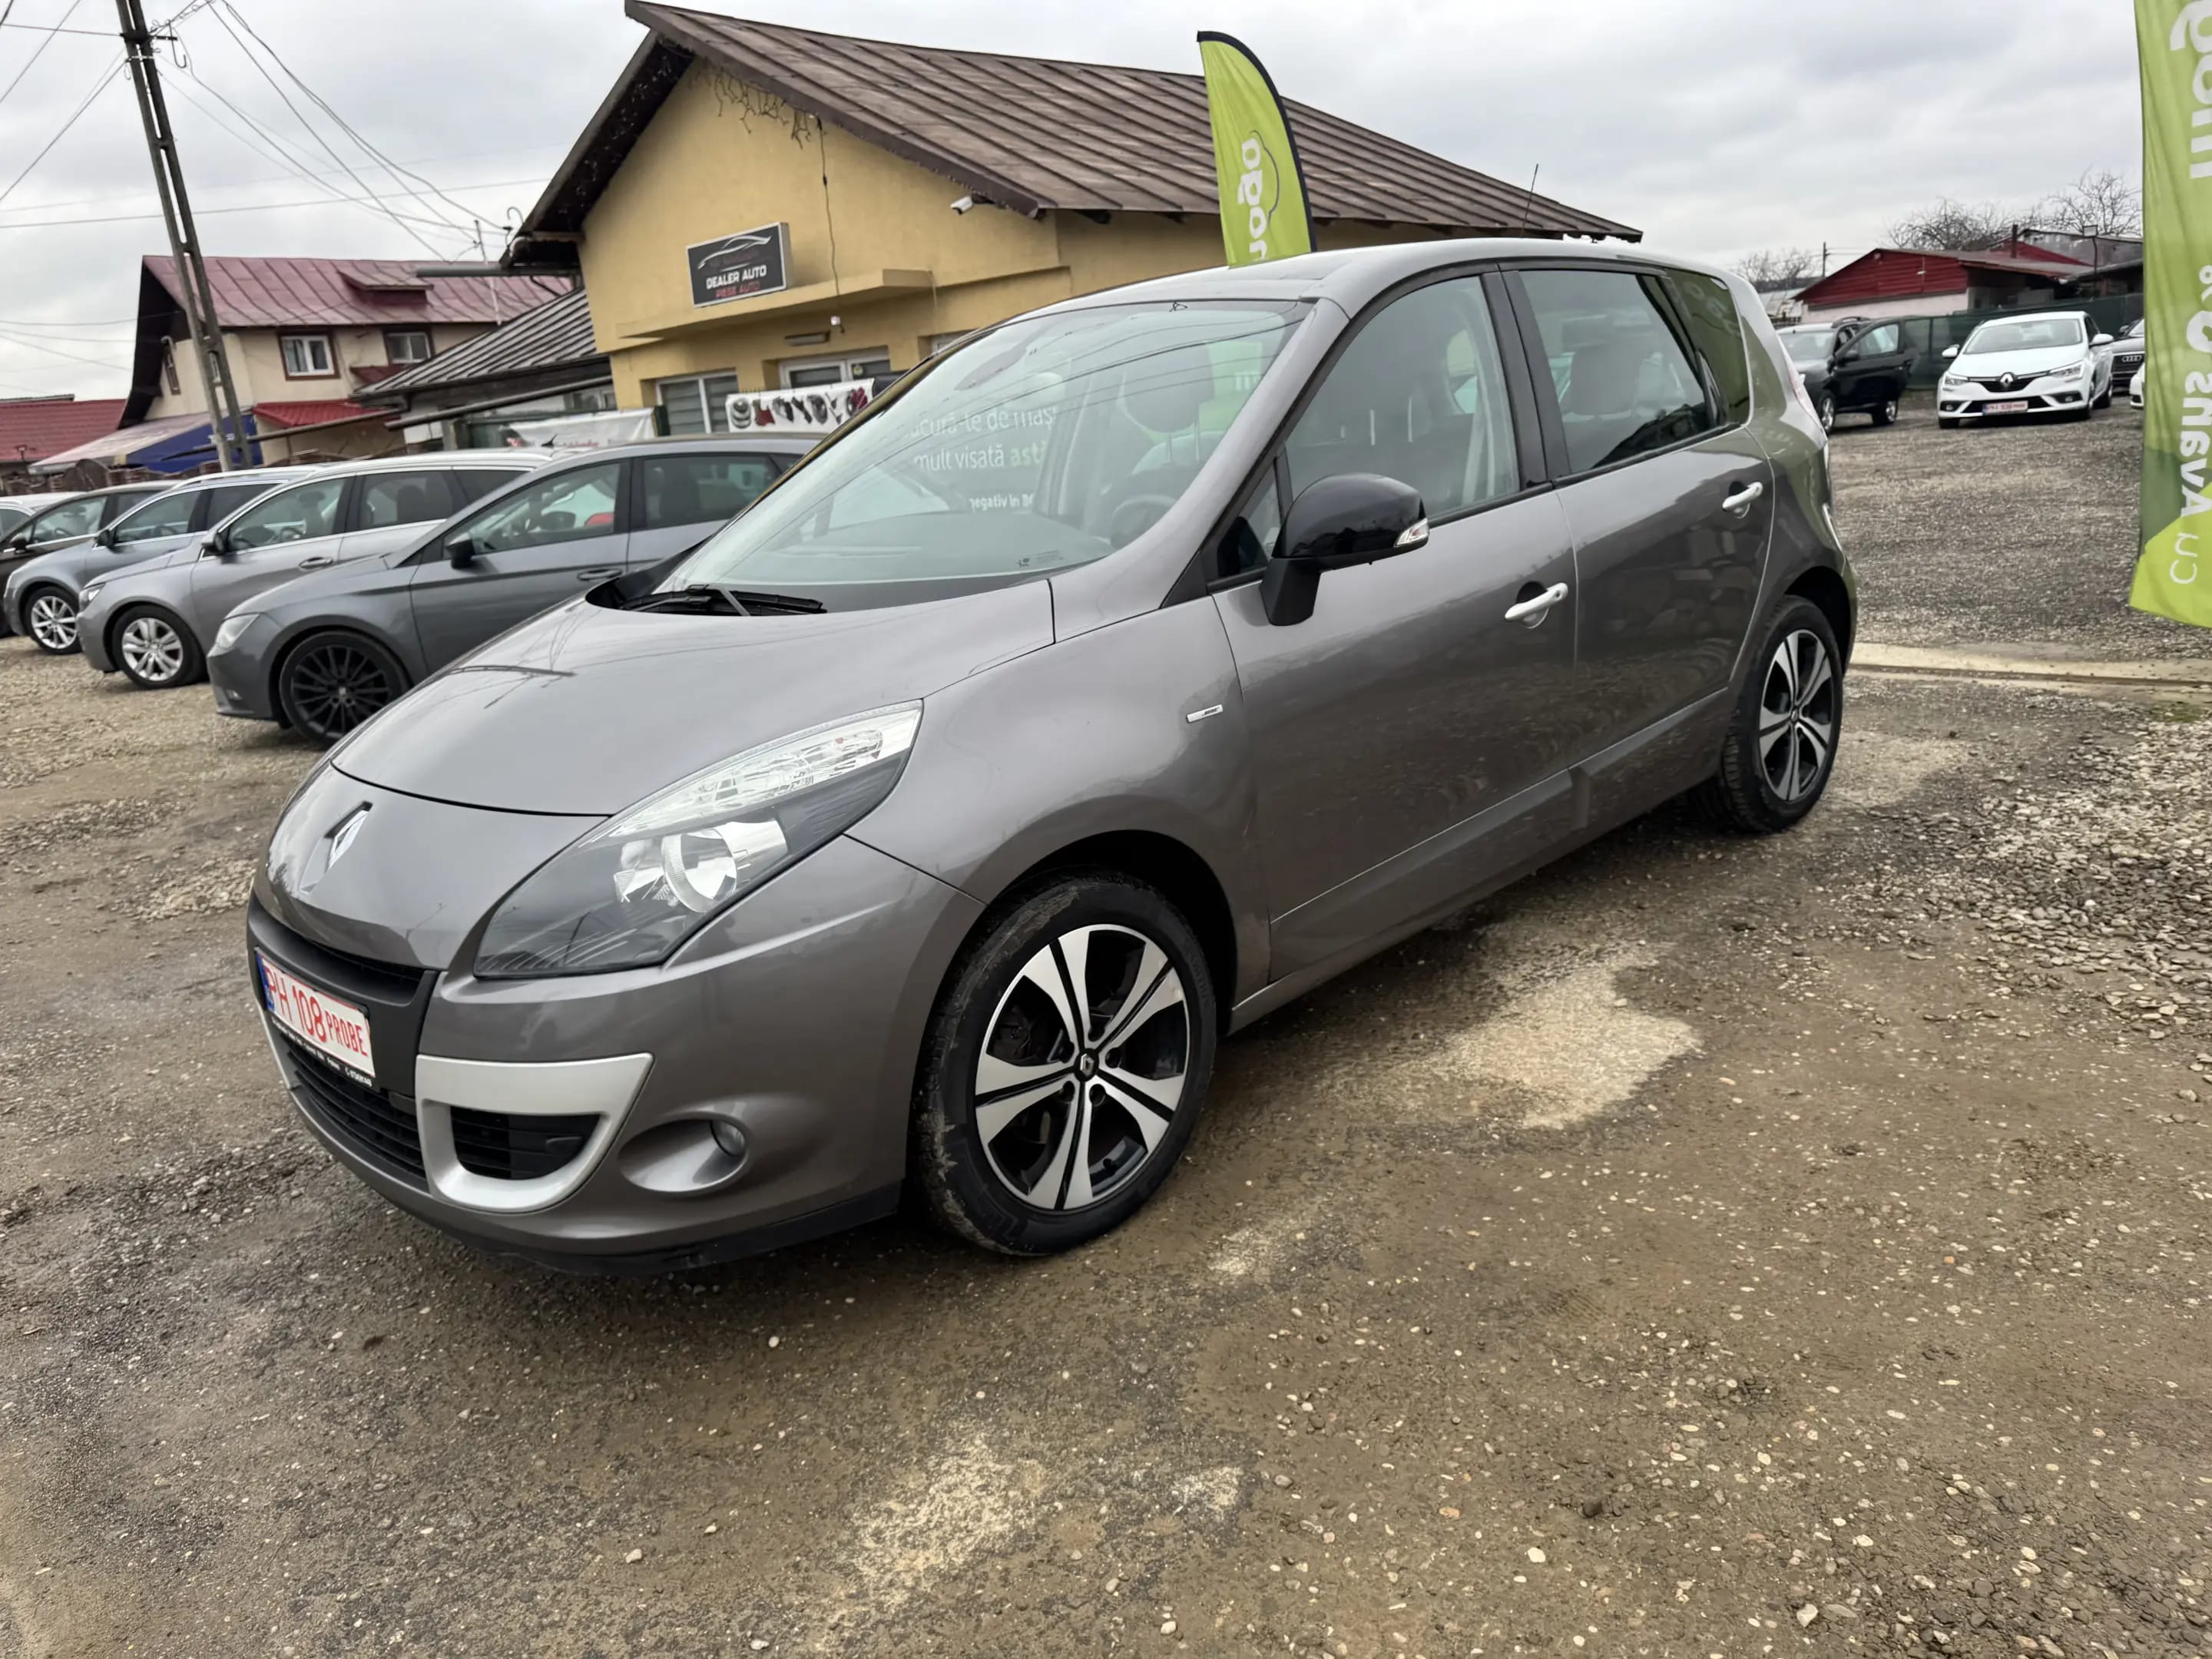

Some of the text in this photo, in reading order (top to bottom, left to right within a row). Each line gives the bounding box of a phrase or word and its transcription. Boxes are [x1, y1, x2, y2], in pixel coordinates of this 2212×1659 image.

[706, 265, 767, 290] DEALER AUTO
[987, 408, 1010, 430] de
[954, 443, 1004, 469] visată
[263, 965, 293, 1022] PH
[292, 985, 326, 1043] 108
[324, 1009, 368, 1057] PROBE
